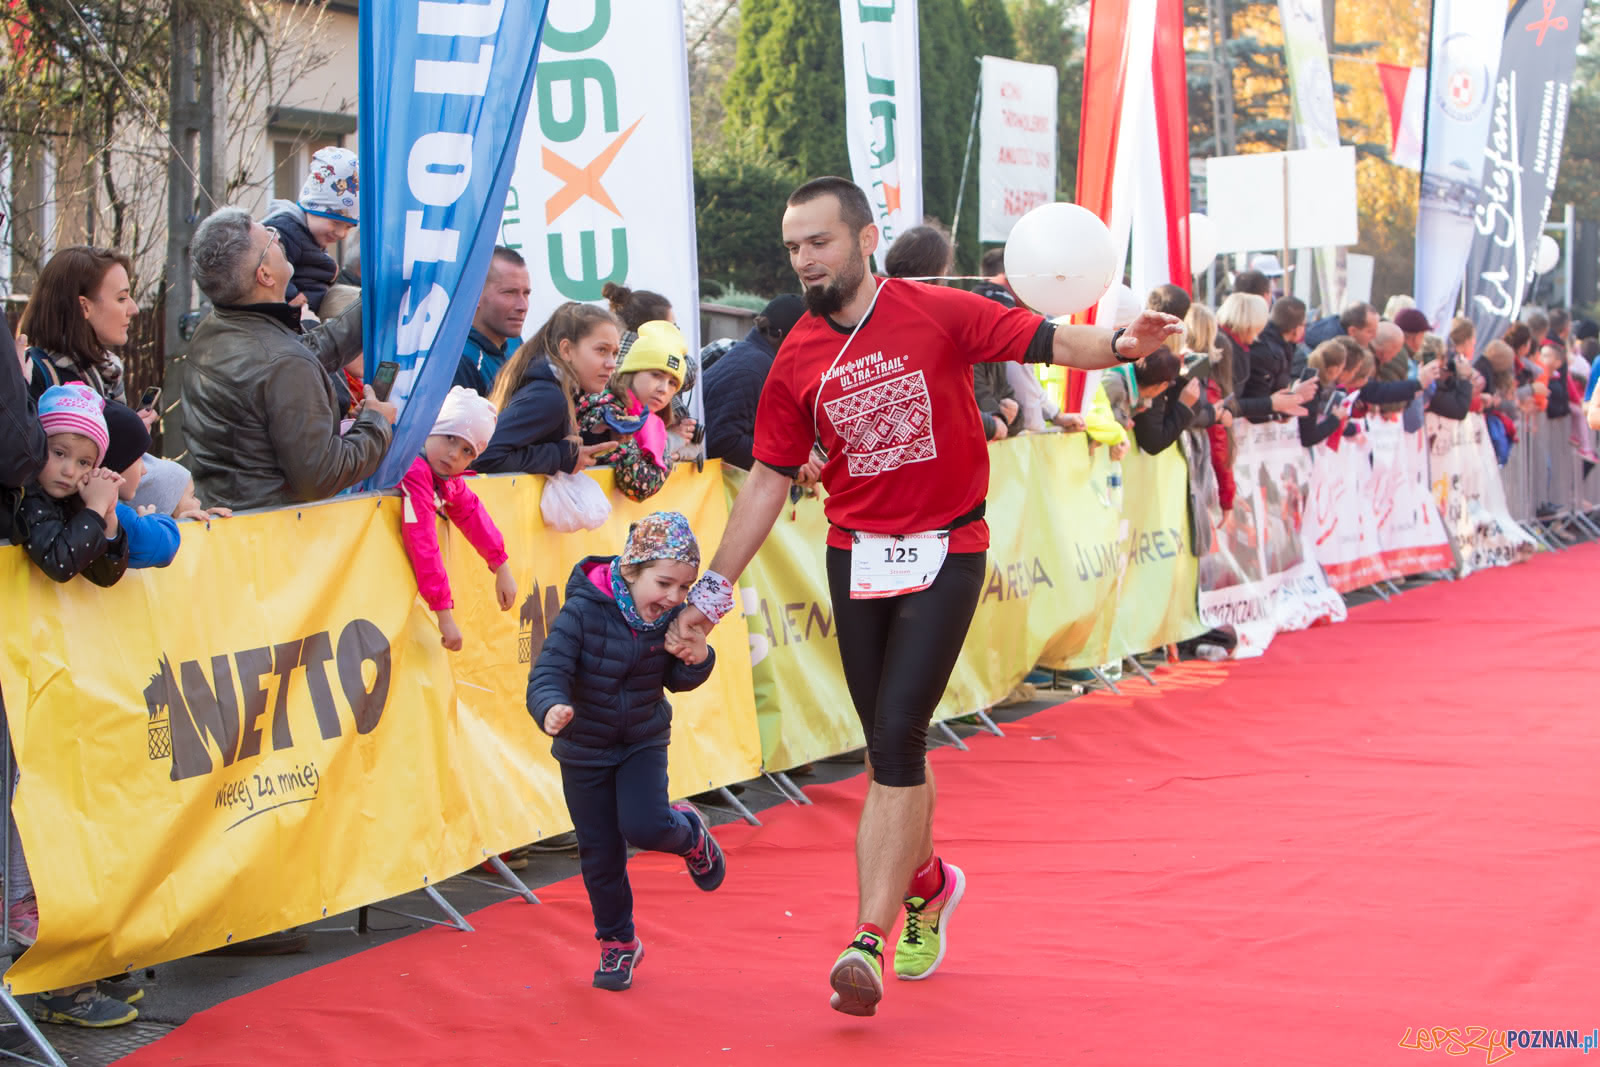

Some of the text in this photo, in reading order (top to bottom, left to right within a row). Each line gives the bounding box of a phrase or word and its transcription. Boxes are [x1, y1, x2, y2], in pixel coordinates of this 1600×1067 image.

[1474, 75, 1525, 249] Stefana
[1533, 79, 1556, 175] HURTOWNIA
[840, 356, 904, 387] ULTRA-TRAIL
[884, 547, 919, 563] 125
[163, 618, 392, 783] NETTO
[214, 777, 255, 812] więcej
[278, 761, 320, 796] mniej
